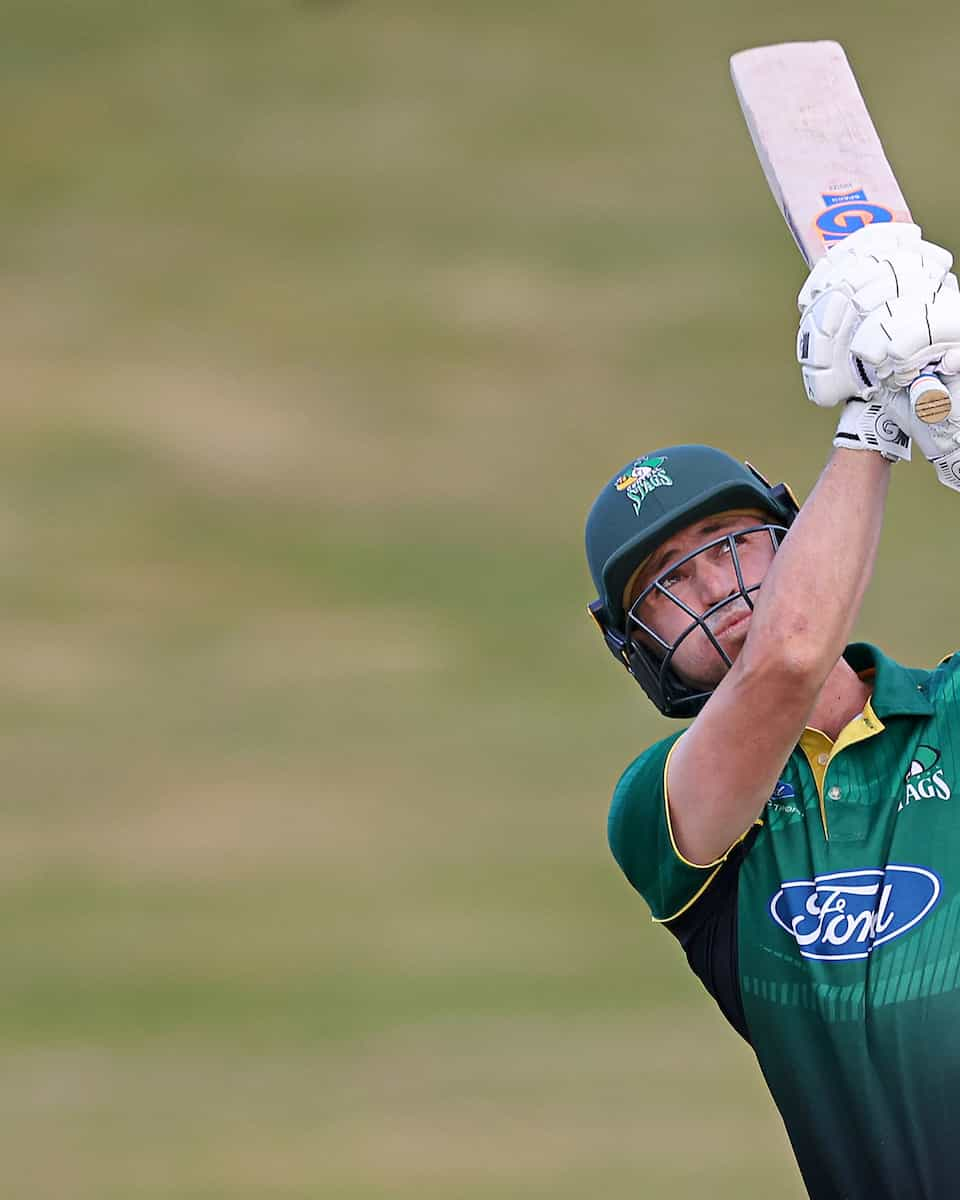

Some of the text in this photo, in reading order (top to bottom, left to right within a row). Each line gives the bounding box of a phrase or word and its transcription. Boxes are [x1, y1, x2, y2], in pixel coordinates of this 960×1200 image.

[627, 469, 673, 516] STAGS
[897, 768, 951, 812] AGS
[791, 883, 894, 946] Ford
